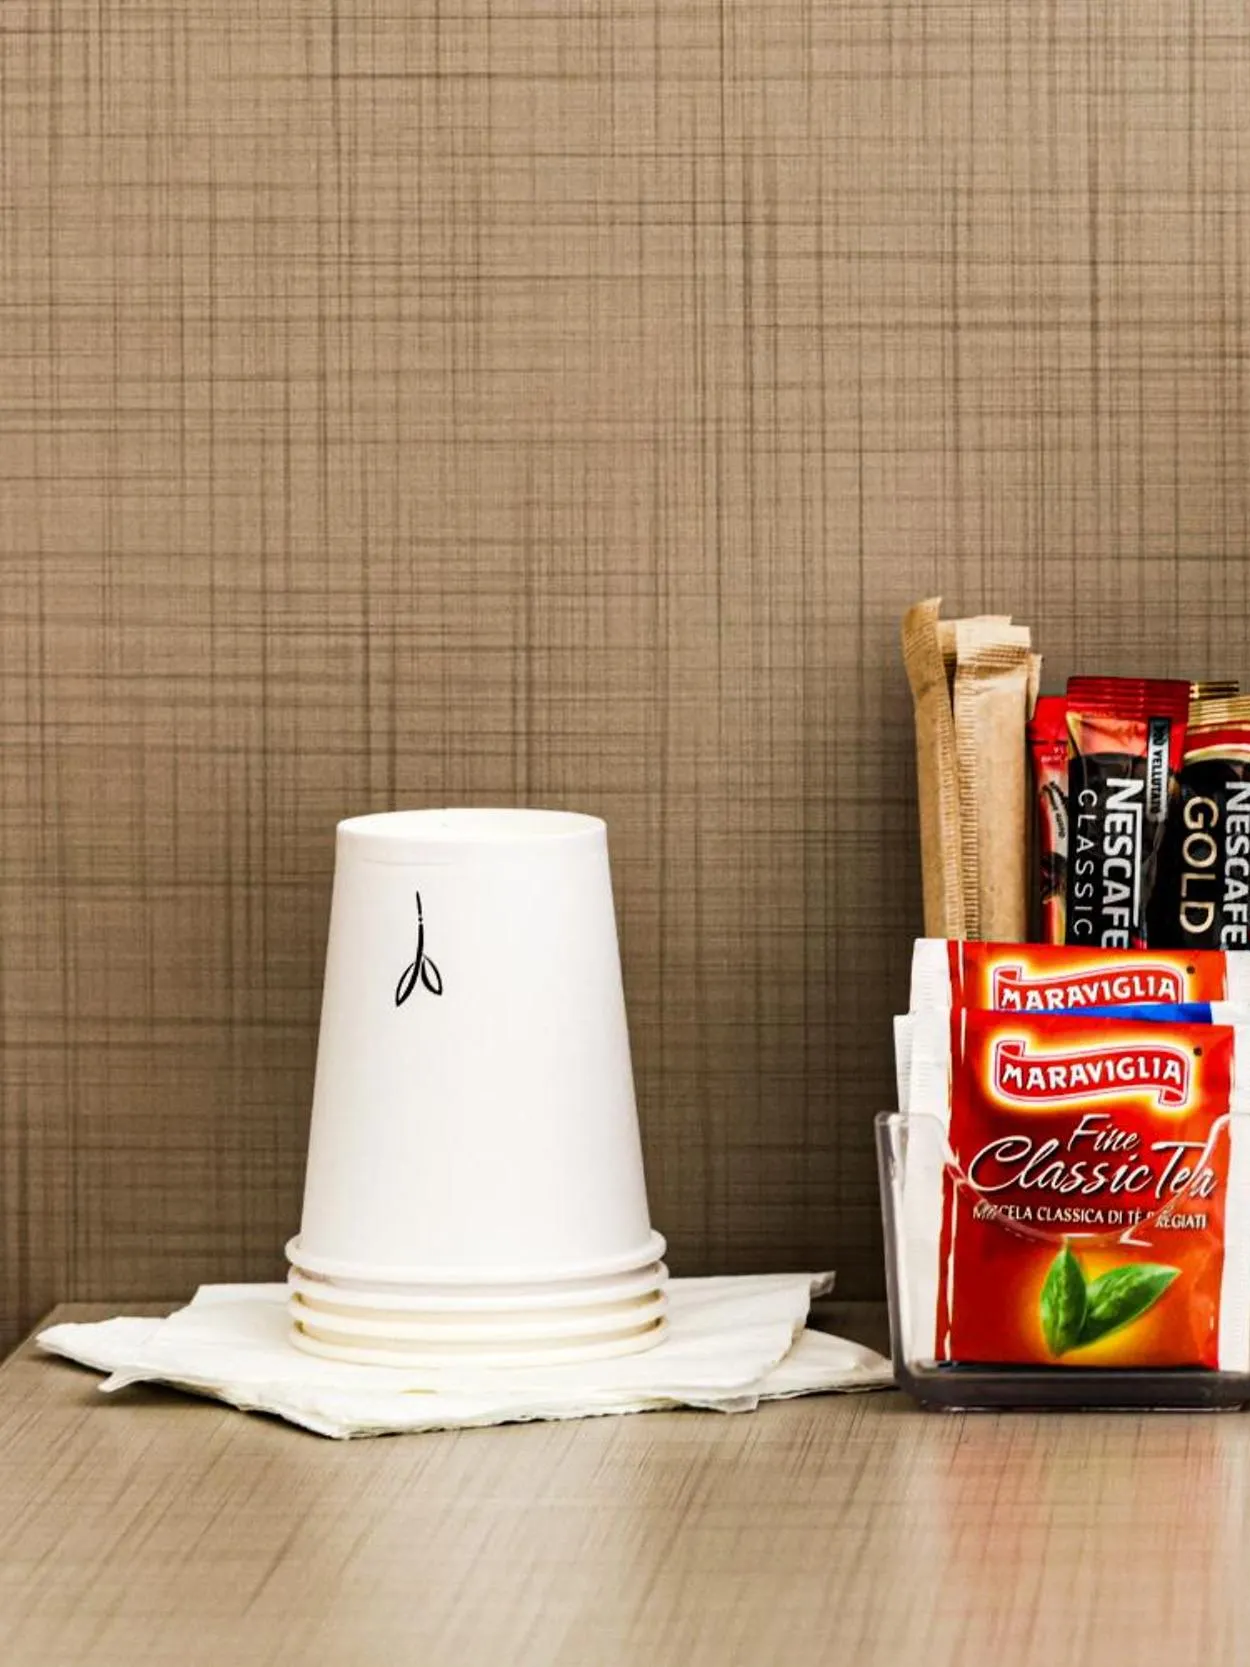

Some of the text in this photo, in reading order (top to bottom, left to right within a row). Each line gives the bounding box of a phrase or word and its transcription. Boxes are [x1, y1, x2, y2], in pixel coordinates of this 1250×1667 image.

[1073, 788, 1099, 937] CLASSIC
[1178, 795, 1220, 935] GOLD
[1001, 975, 1177, 1011] MARAVIGLIA
[1002, 1055, 1183, 1091] MARAVIGLIA
[1067, 1112, 1142, 1152] Fine
[967, 1135, 1219, 1199] Classic Tea
[1036, 1204, 1105, 1224] CLASSICA
[1107, 1212, 1124, 1225] DI
